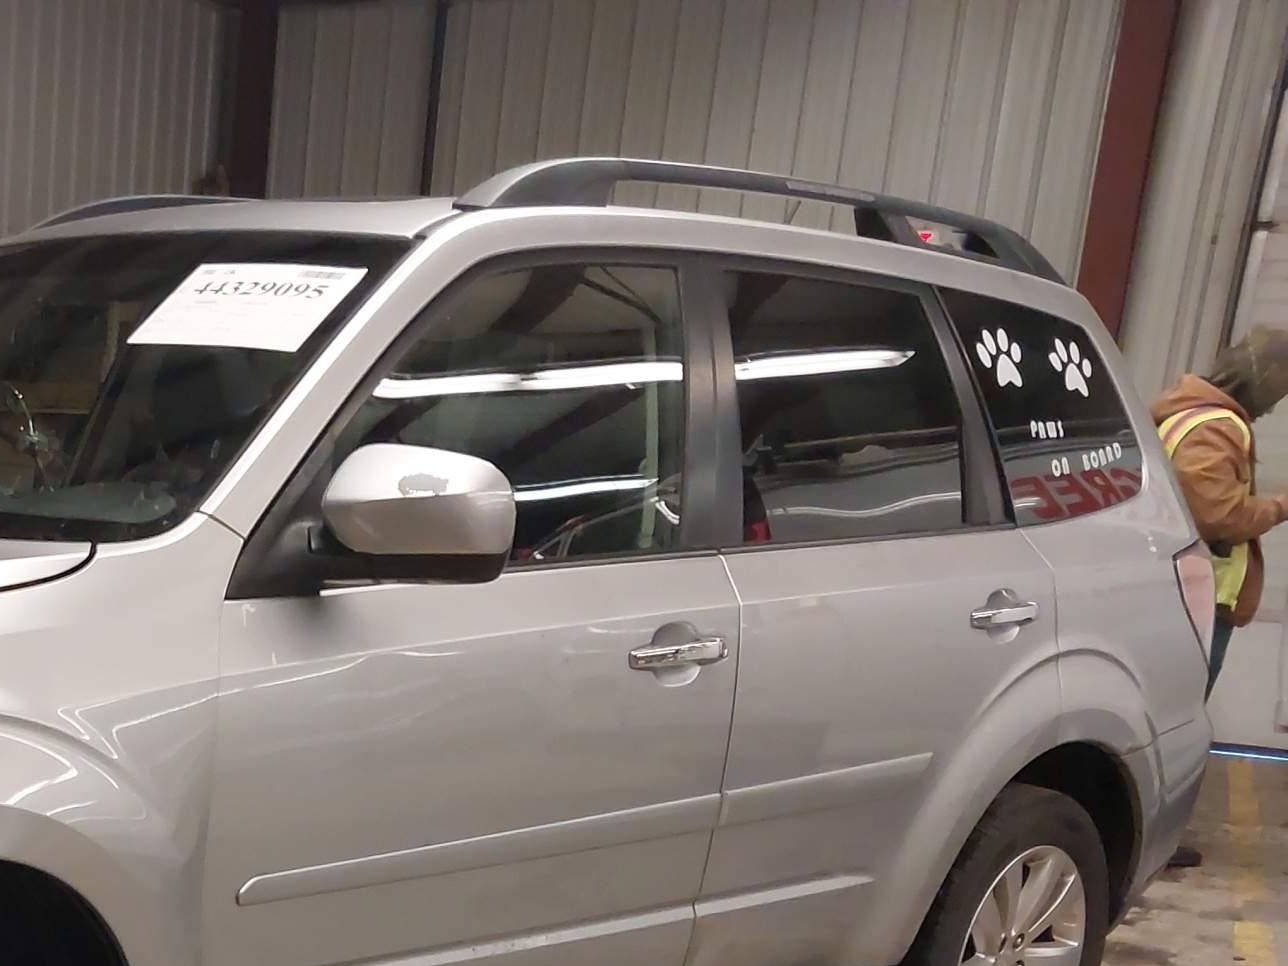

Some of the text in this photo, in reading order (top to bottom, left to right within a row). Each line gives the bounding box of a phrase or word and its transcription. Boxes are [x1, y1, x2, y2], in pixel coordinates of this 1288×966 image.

[193, 281, 329, 299] 44329095
[1030, 420, 1064, 439] PAWS
[1052, 442, 1122, 477] ON BOARD
